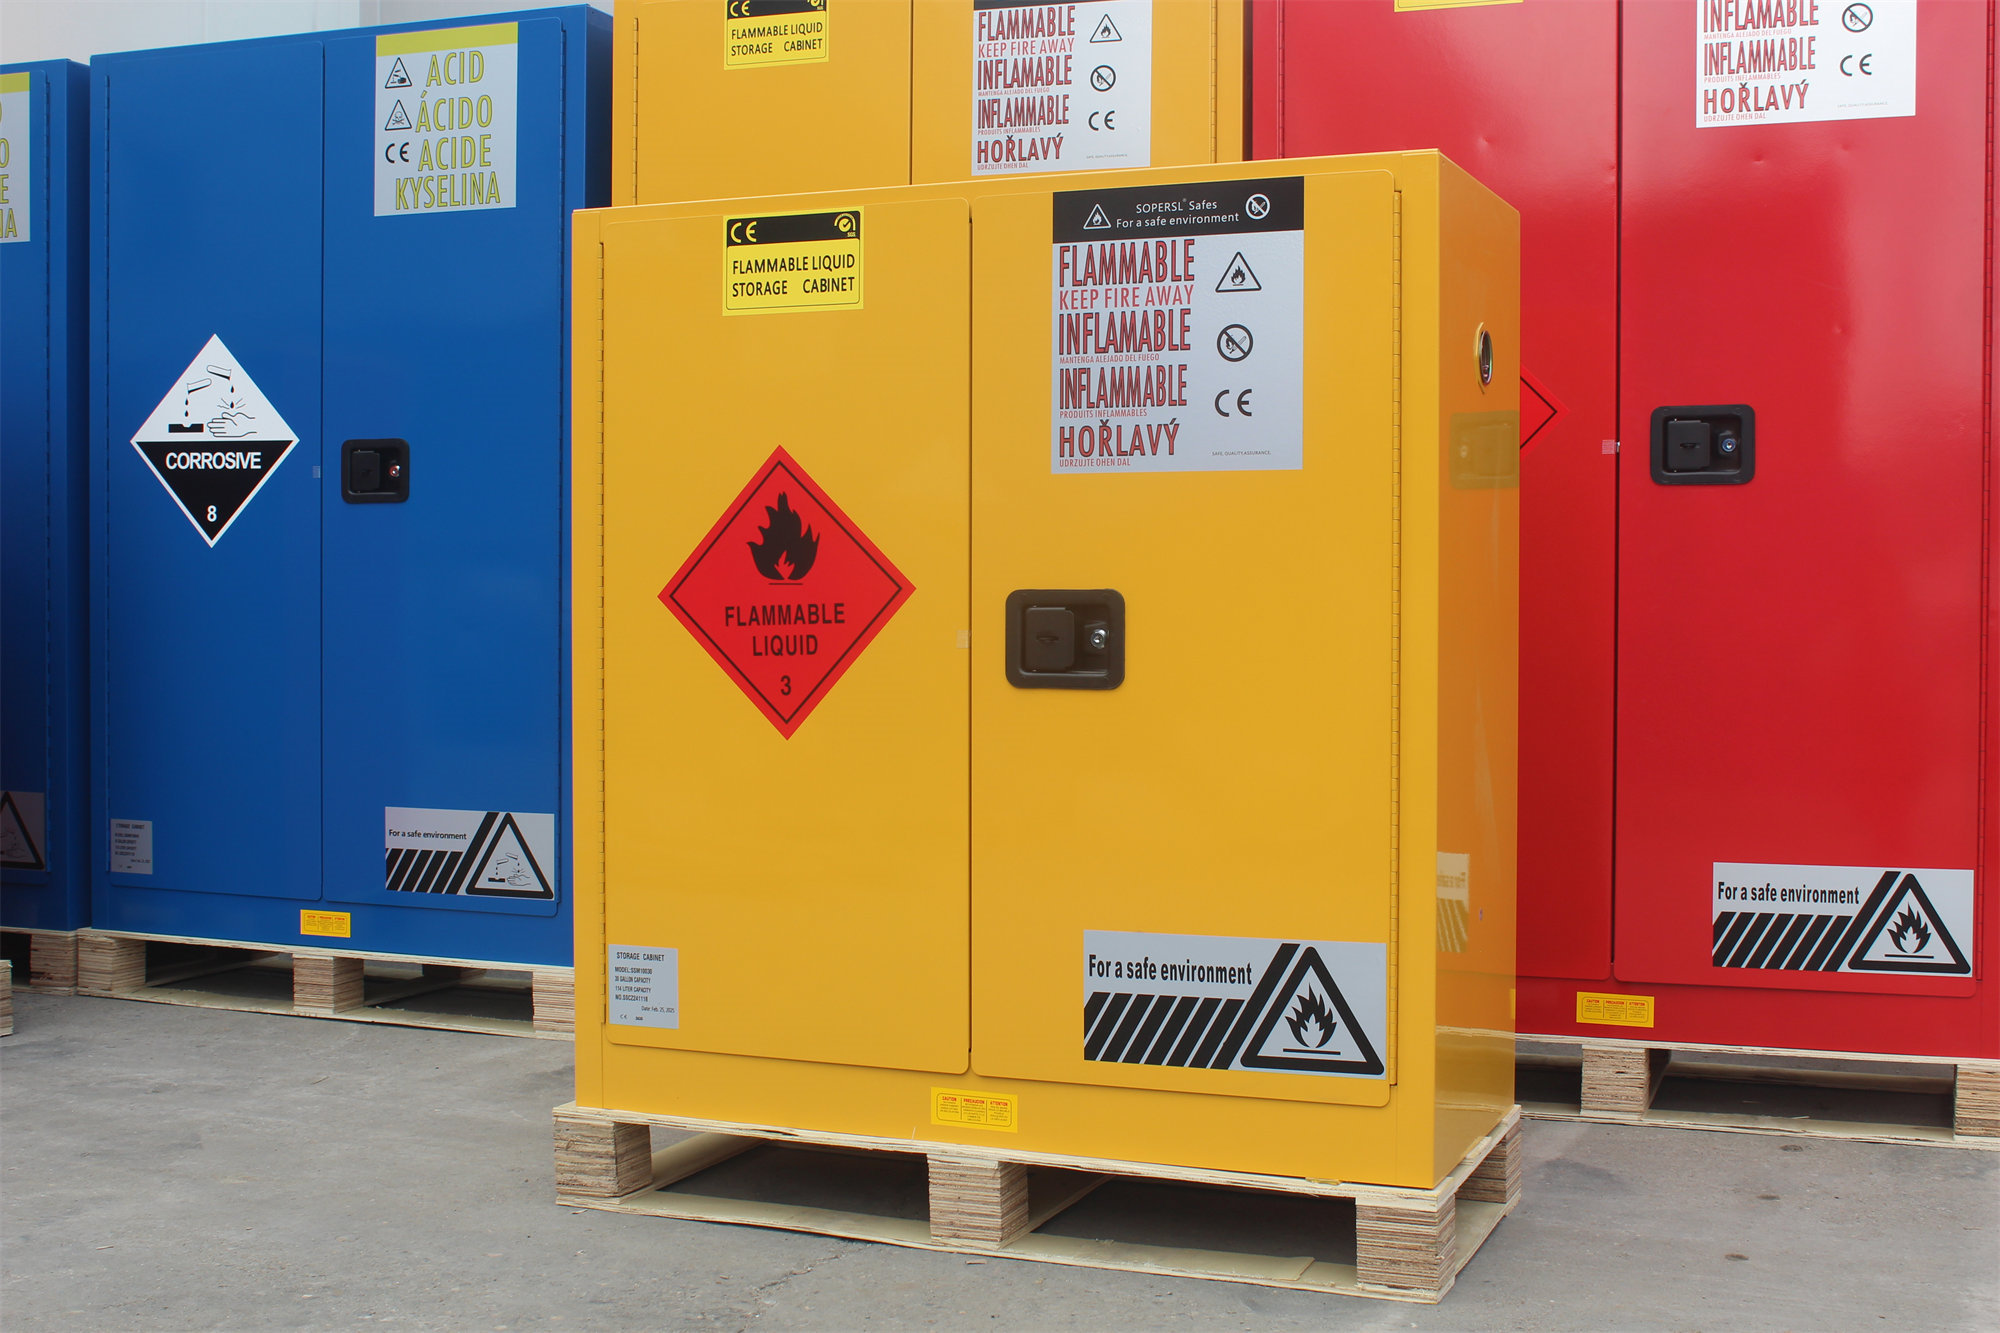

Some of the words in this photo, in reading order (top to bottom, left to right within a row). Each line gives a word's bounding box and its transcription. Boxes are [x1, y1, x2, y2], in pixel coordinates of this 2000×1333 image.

[978, 5, 1076, 41] FLAMMABLE
[1704, 0, 1819, 33] INFLAMABLE
[732, 25, 788, 39] FLAMMABLE
[791, 22, 822, 35] LIQUID
[731, 43, 773, 56] STORAGE
[784, 38, 822, 51] CABINET
[978, 42, 1007, 58] KEEP
[1010, 40, 1036, 56] FIRE
[1040, 38, 1074, 54] AWAY
[1704, 36, 1816, 76] INFLAMMABLE
[426, 51, 484, 87] ACID
[978, 55, 1072, 90] INFLAMABLE
[1840, 54, 1872, 76] CE
[1704, 79, 1809, 114] HOŘLAVÝ
[416, 90, 492, 132] ÁCIDO
[978, 94, 1069, 129] INFLAMMABLE
[1088, 111, 1115, 131] CE
[385, 142, 409, 163] CE
[418, 134, 491, 171] ACIDE
[977, 133, 1064, 163] HOŘLAVÝ
[396, 171, 500, 210] KYSELINA
[1189, 200, 1217, 211] Safes
[1116, 219, 1133, 228] For
[1145, 216, 1166, 226] safe
[1170, 212, 1239, 225] environment
[730, 221, 757, 243] CE
[733, 257, 808, 274] FLAMMABLE
[812, 254, 855, 271] LIQUID
[1060, 239, 1195, 287] FLAMMABLE
[732, 280, 788, 297] STORAGE
[803, 277, 854, 293] CABINET
[1060, 290, 1099, 310] KEEP
[1105, 287, 1140, 308] FIRE
[1145, 284, 1194, 306] AWAY
[1059, 308, 1191, 355] INFLAMABLE
[1060, 356, 1094, 364] MANTENGA
[1096, 354, 1123, 363] ALEJADO
[1126, 354, 1136, 362] DEL
[1138, 353, 1160, 361] FUEGO
[1060, 364, 1187, 409] INFLAMMABLE
[1060, 410, 1093, 419] PRODUITS
[1095, 408, 1147, 418] INFLAMMABLES
[1215, 389, 1252, 417] CE
[1060, 418, 1180, 458] HOŘLAVÝ
[165, 452, 262, 470] CORROSIVE
[1060, 459, 1094, 467] UDRZUJTE
[1117, 458, 1131, 466] DAL
[207, 505, 217, 522] 8
[725, 603, 845, 626] FLAMMABLE
[753, 634, 818, 656] LIQUID
[780, 675, 791, 695] 3
[407, 830, 421, 838] safe
[423, 831, 467, 840] environment
[1718, 882, 1737, 900] For
[1741, 887, 1747, 900] a
[1751, 883, 1777, 901] safe
[1780, 884, 1859, 904] environment
[617, 952, 640, 960] STORAGE
[1089, 954, 1111, 978] For
[1115, 960, 1123, 978] a
[1126, 957, 1156, 980] safe
[1161, 959, 1252, 985] environment
